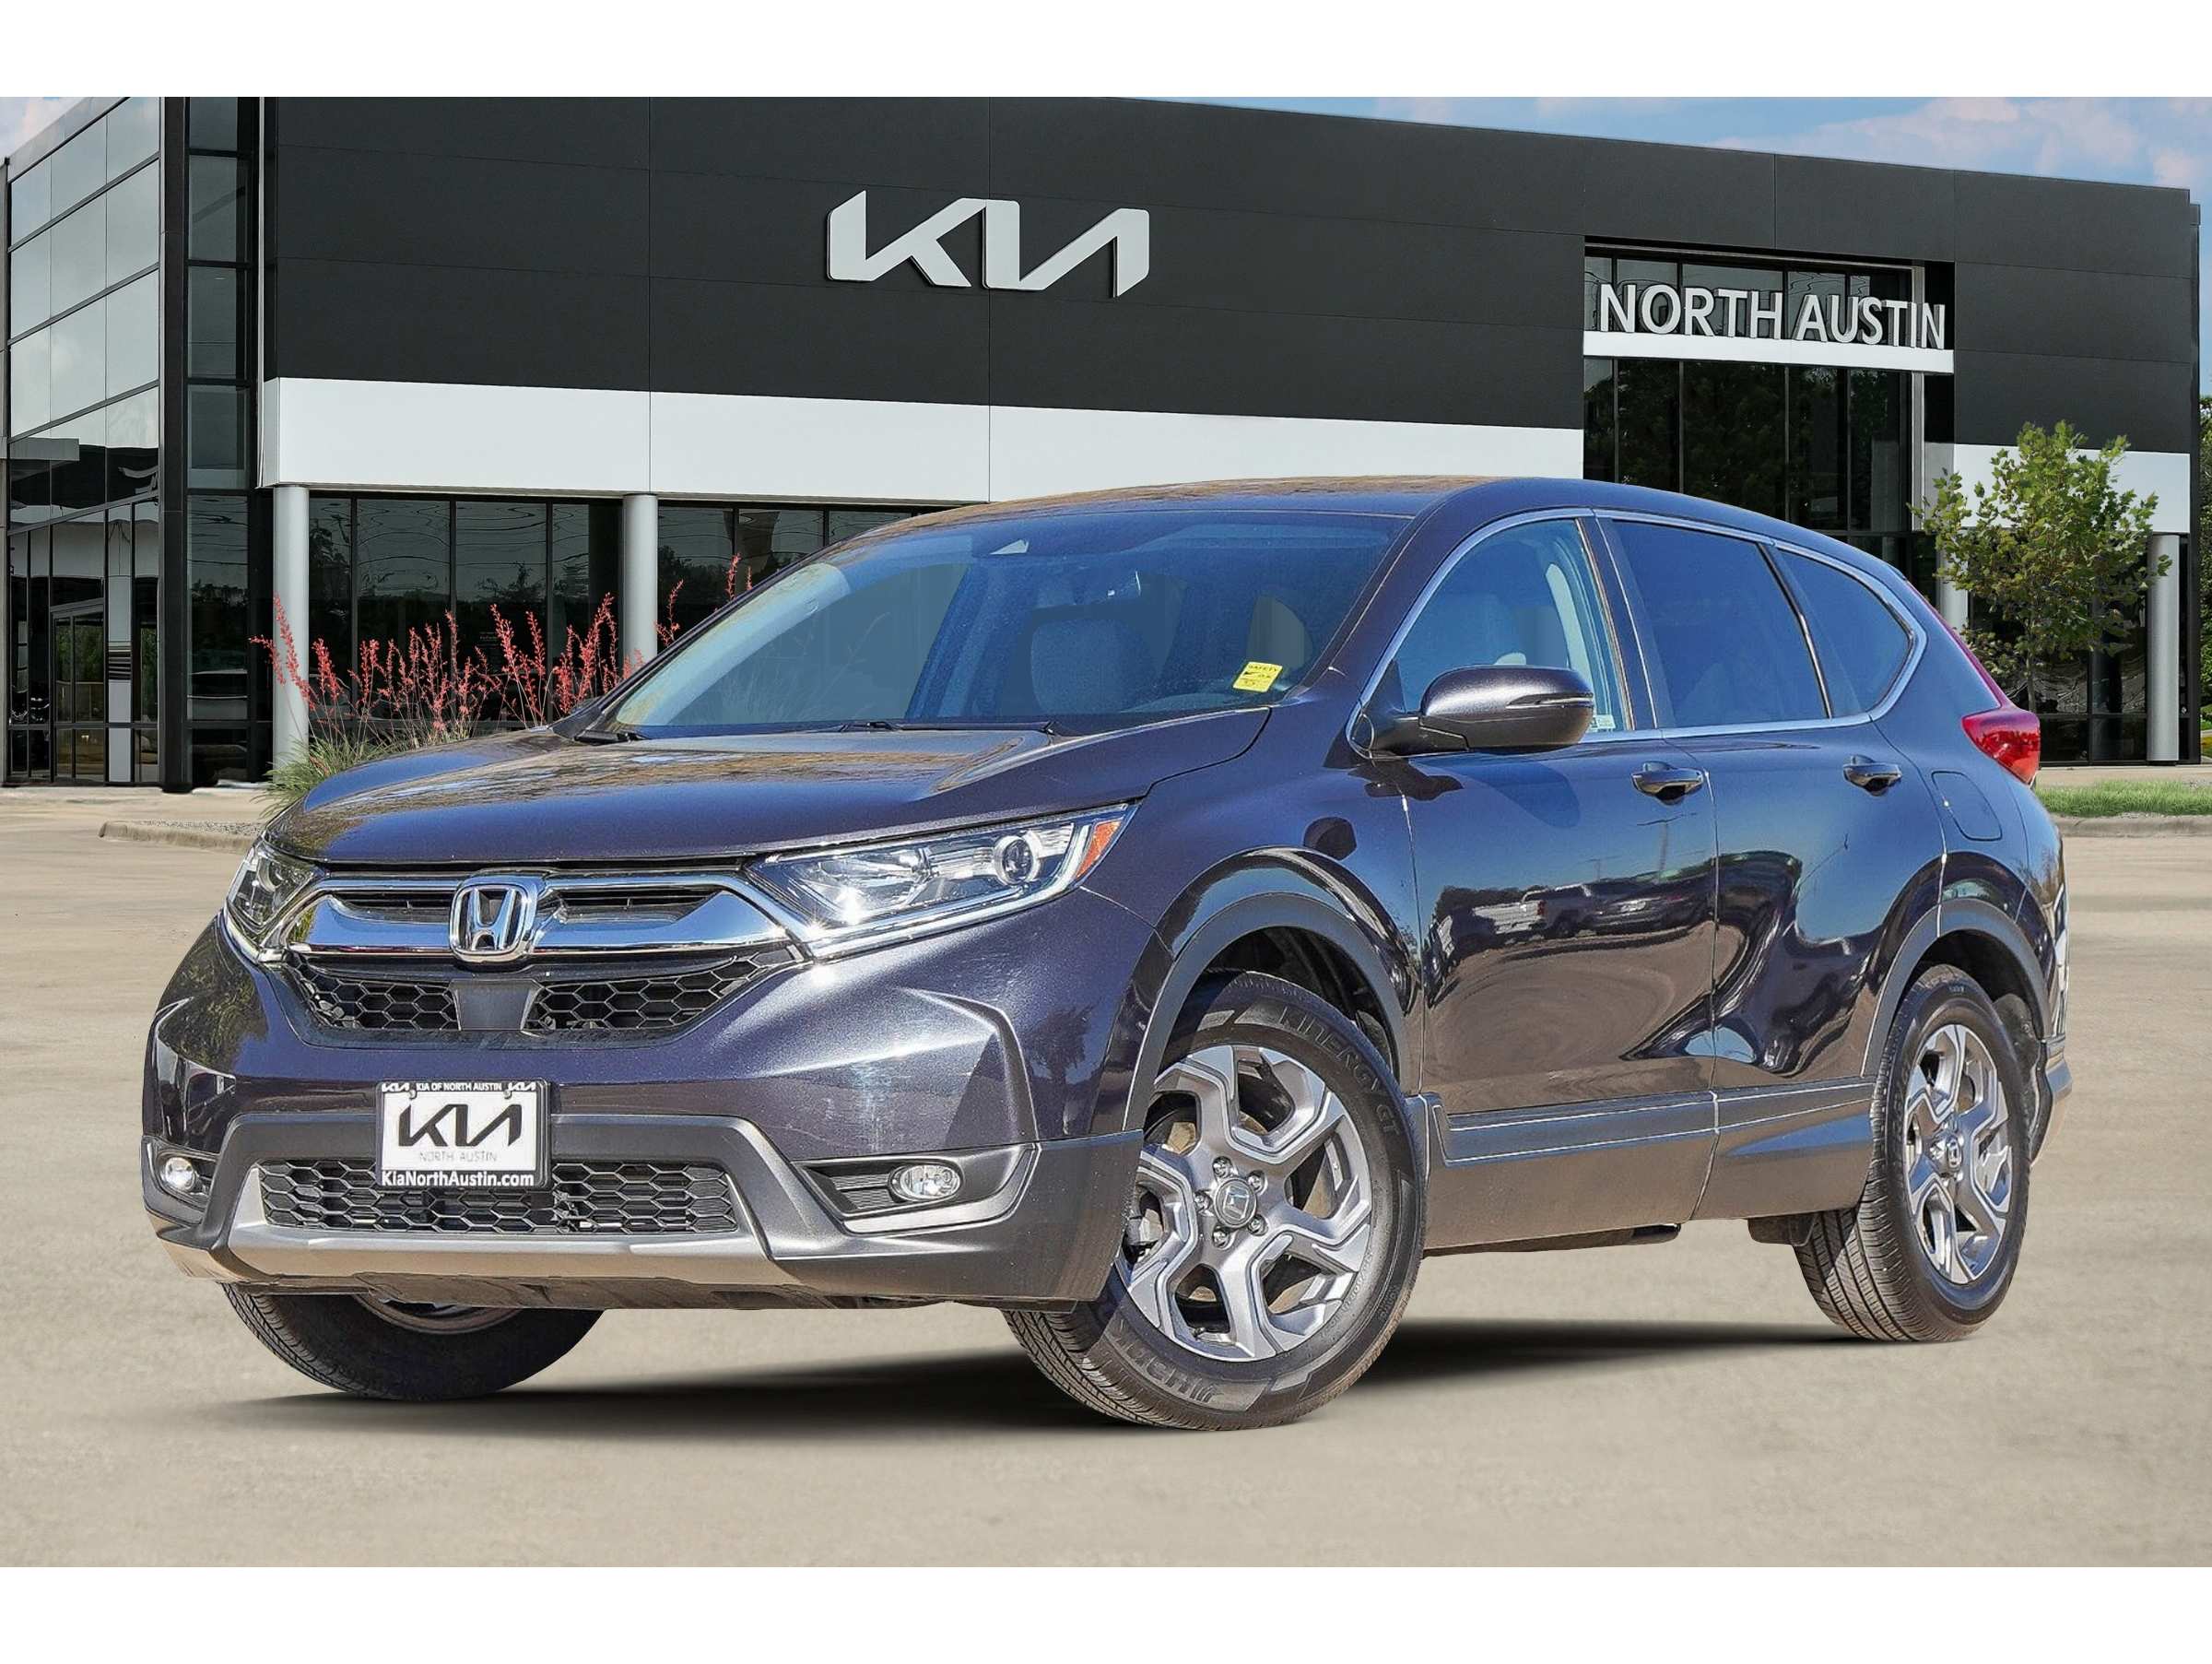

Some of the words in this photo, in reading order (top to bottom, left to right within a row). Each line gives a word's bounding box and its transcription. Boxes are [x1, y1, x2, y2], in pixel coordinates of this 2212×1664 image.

[827, 190, 1149, 298] KIA
[1599, 283, 1783, 340] NORTH
[1793, 293, 1947, 350] AUSTIN
[416, 1082, 430, 1092] KIA
[430, 1082, 443, 1092] OF
[443, 1082, 472, 1092] NORTH
[472, 1082, 502, 1092] AUSTIN
[398, 1103, 523, 1147] KIA
[419, 1151, 454, 1162] NORTH
[460, 1151, 498, 1162] AUSTIN
[382, 1170, 535, 1187] KiaNorthAustin.com
